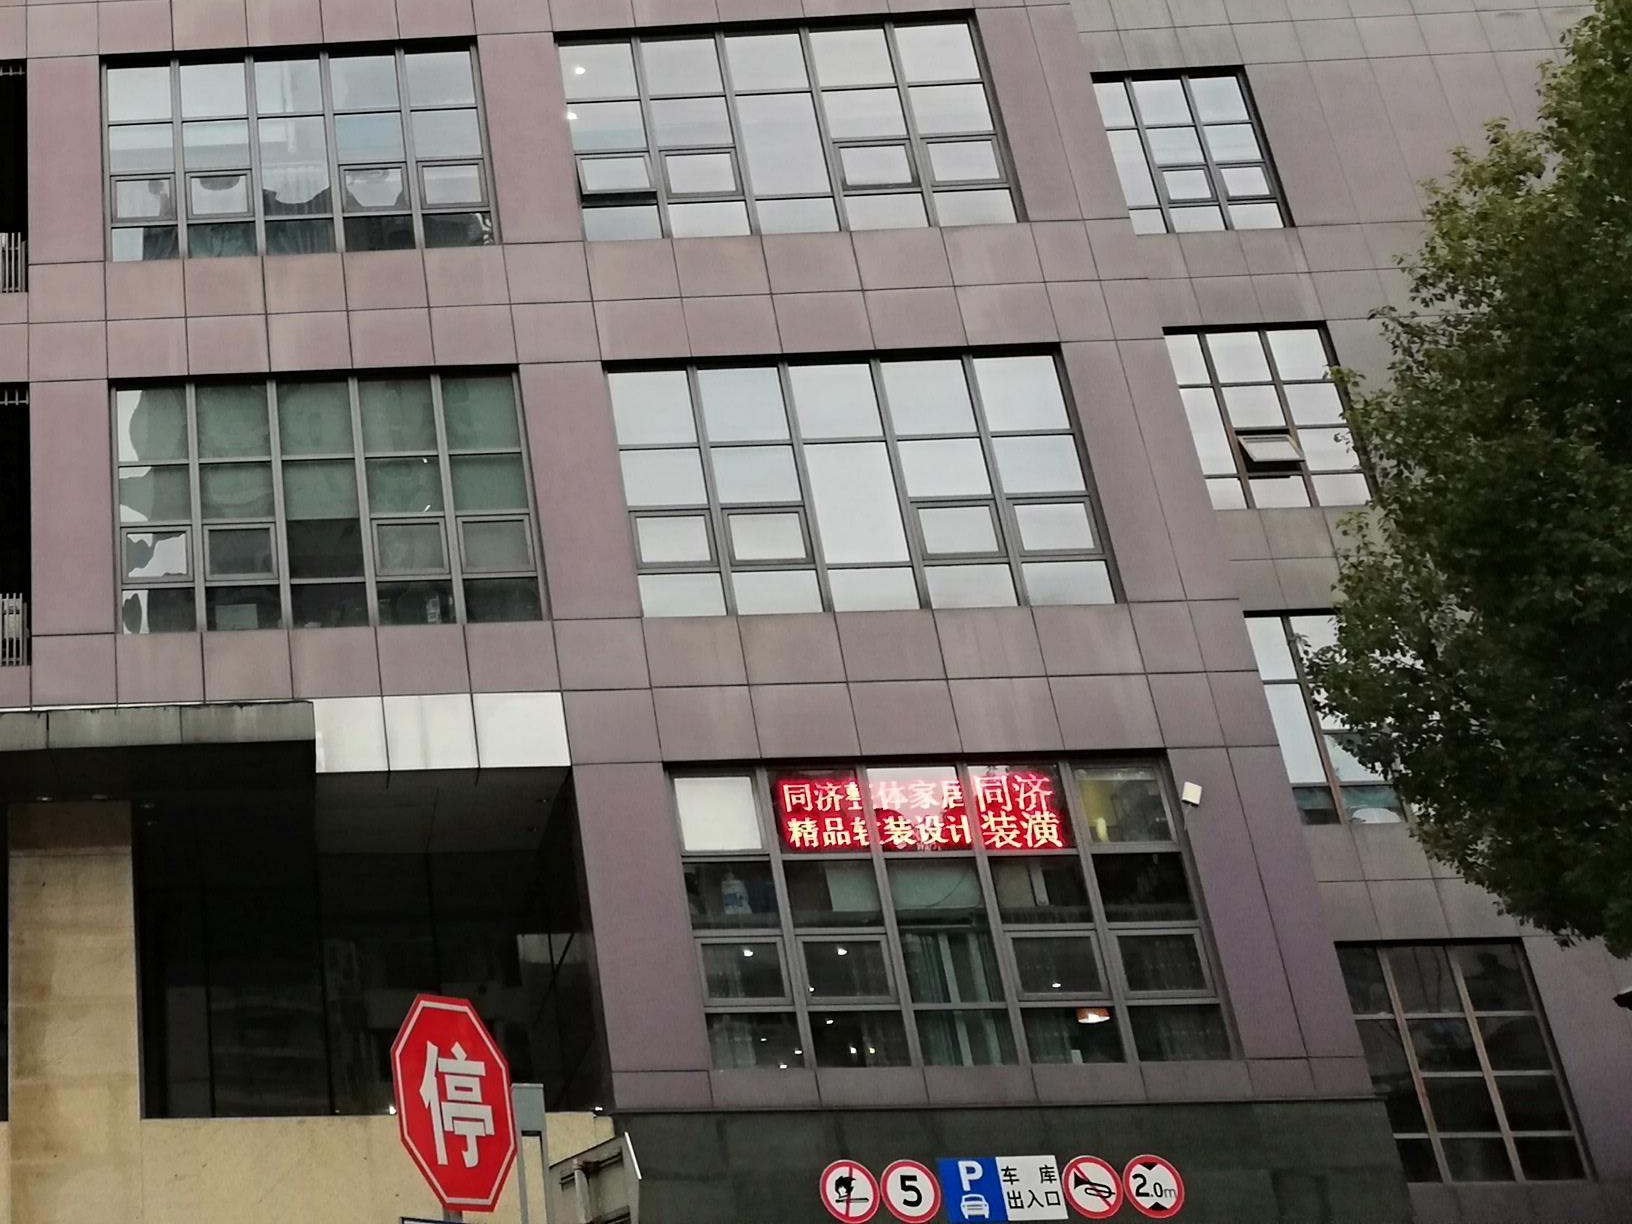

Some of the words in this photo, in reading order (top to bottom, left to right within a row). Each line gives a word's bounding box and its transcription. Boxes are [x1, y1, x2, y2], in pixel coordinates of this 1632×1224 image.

[974, 774, 1054, 813] 同济
[980, 810, 1064, 849] 装潢
[419, 1040, 495, 1168] 停
[900, 1174, 923, 1208] 5
[958, 1160, 983, 1192] P
[1000, 1164, 1058, 1185] 车库
[1132, 1173, 1177, 1198] 2.0m
[1007, 1189, 1062, 1210] 出入口
